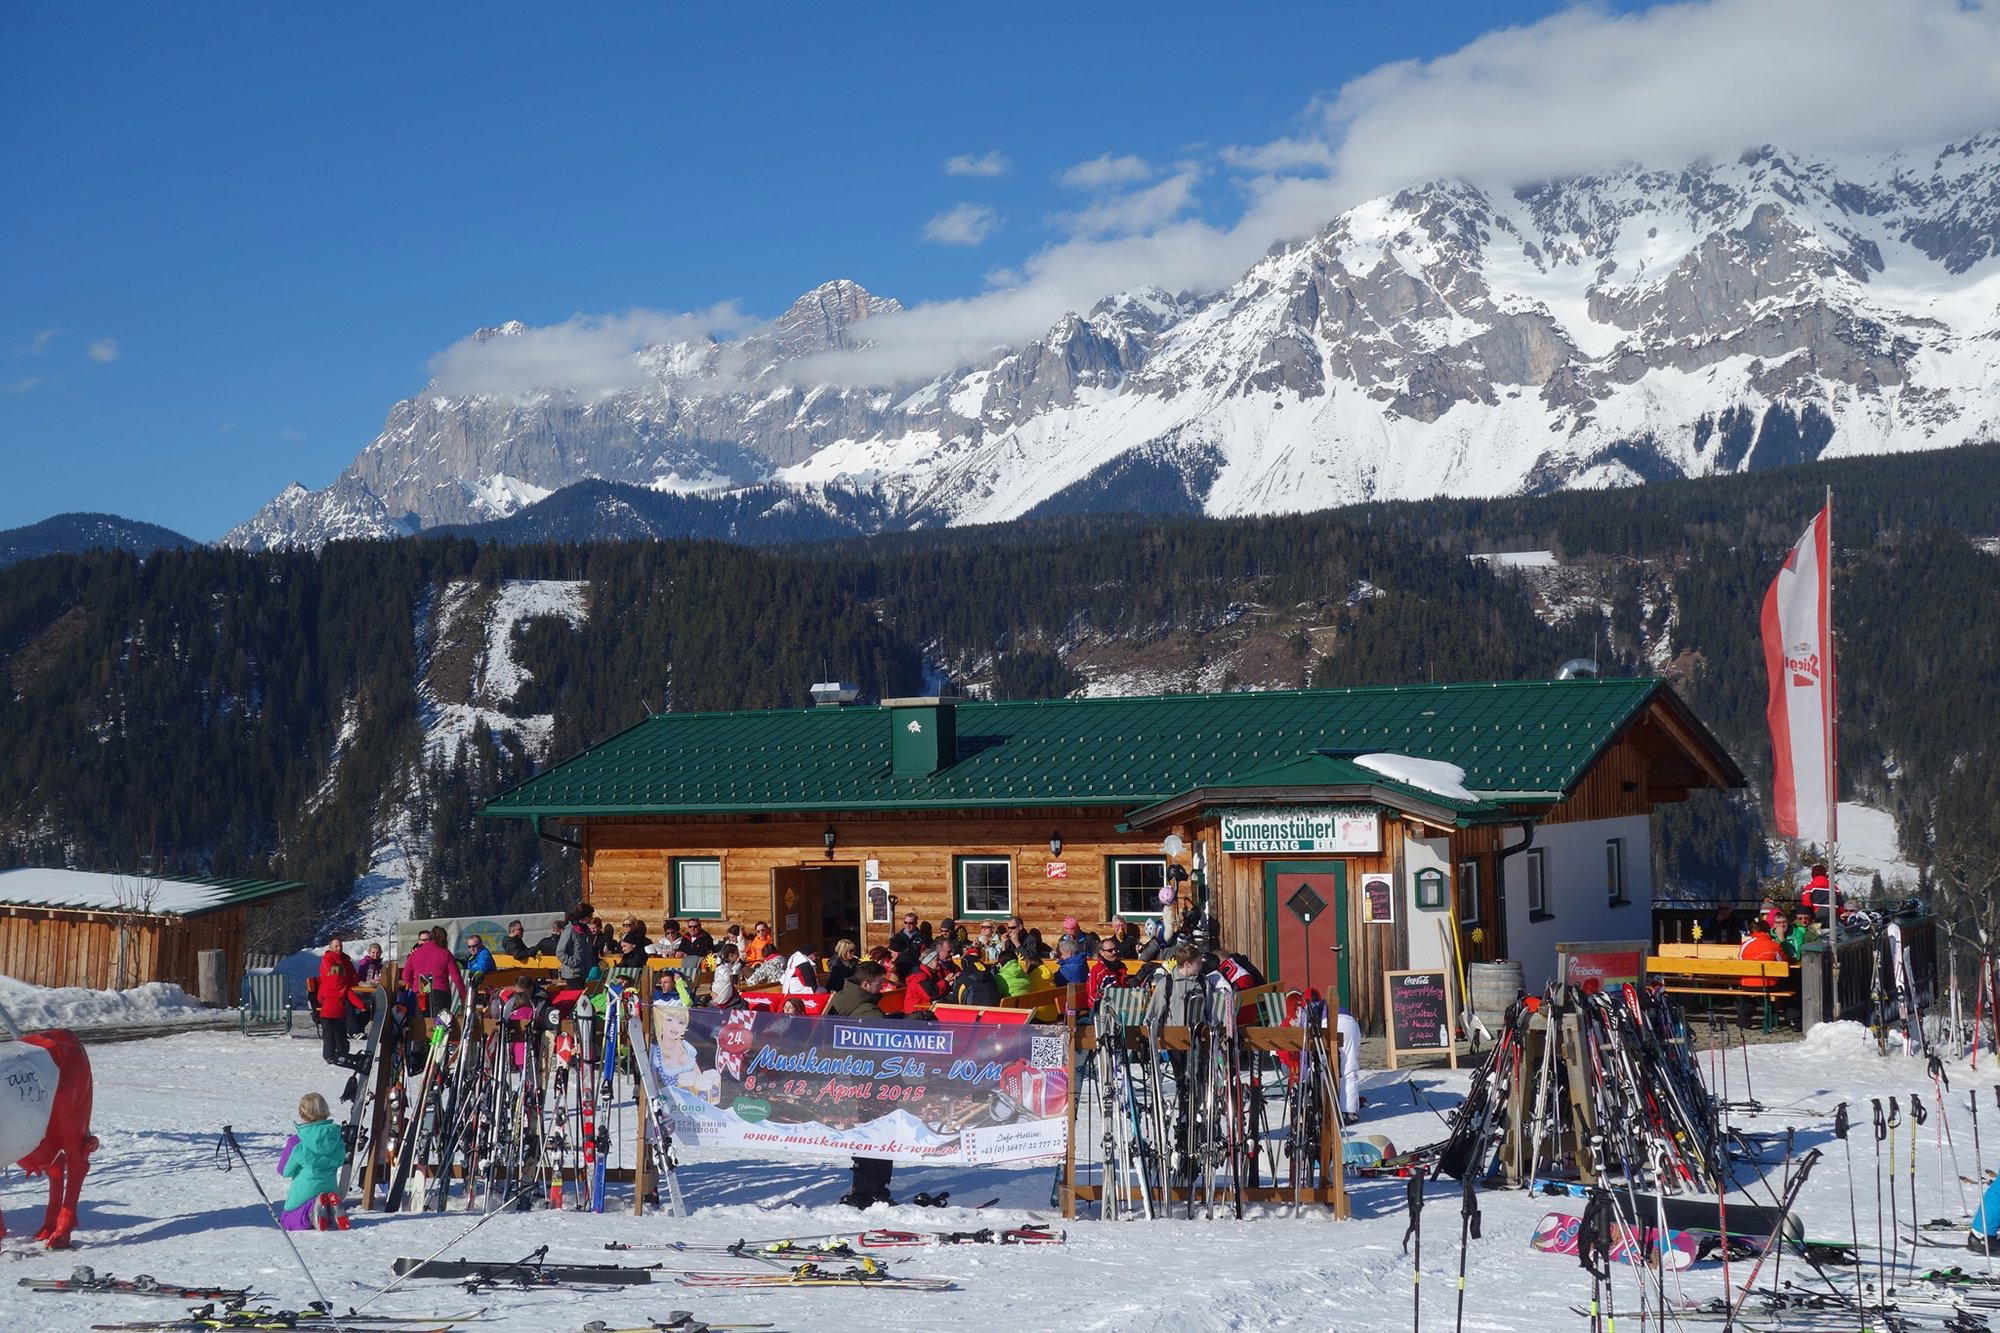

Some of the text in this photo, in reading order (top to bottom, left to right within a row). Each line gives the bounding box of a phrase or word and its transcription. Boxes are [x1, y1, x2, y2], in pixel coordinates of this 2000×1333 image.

[1225, 817, 1336, 840] Sonnenstüberl
[1234, 841, 1300, 850] EINGANG
[726, 1031, 745, 1046] 24.
[841, 1030, 945, 1050] PUNTIGAMER
[747, 1044, 875, 1076] Musikanten
[874, 1056, 925, 1080] Ski
[948, 1059, 1003, 1085] WM
[744, 1075, 762, 1091] 8.
[783, 1079, 813, 1096] 12.
[815, 1077, 872, 1105] April
[876, 1085, 927, 1101] 2015
[677, 1120, 727, 1129] SCHLADMING
[742, 1131, 960, 1155] www.musikanten-ski-wm.at
